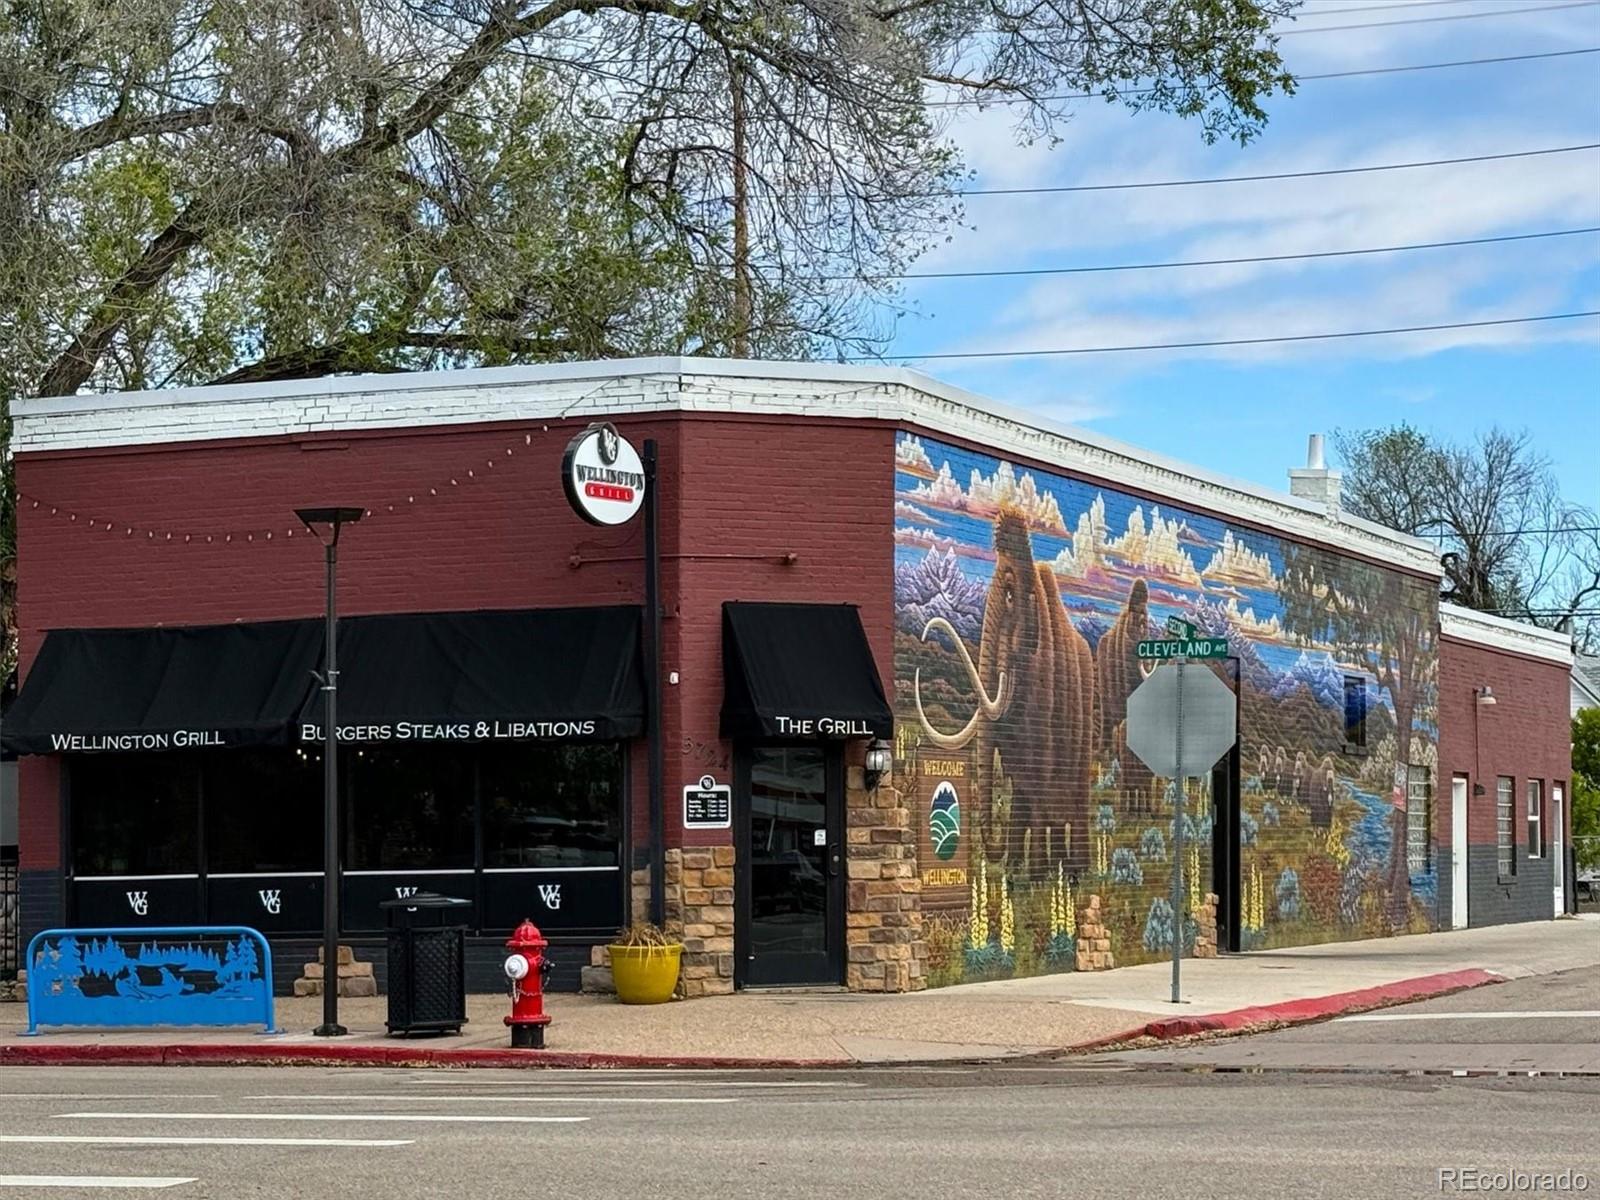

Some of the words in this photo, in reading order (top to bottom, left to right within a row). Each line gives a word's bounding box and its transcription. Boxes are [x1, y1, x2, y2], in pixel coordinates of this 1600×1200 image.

[576, 464, 645, 491] WELLINGTON
[589, 486, 629, 500] GRILL
[1138, 641, 1211, 656] CLEVELAND
[1214, 643, 1227, 652] AVE
[396, 722, 470, 739] STEAKS
[474, 721, 490, 738] &
[494, 720, 595, 738] LIBATIONS
[775, 716, 814, 734] THE
[818, 717, 873, 734] GRILL
[51, 733, 168, 750] WELLINGTON
[173, 730, 226, 746] GRILL
[924, 760, 965, 776] WELCOME
[922, 868, 967, 885] WELLINGTON
[126, 891, 148, 915] WG
[259, 889, 281, 914] WG
[538, 884, 561, 909] WG
